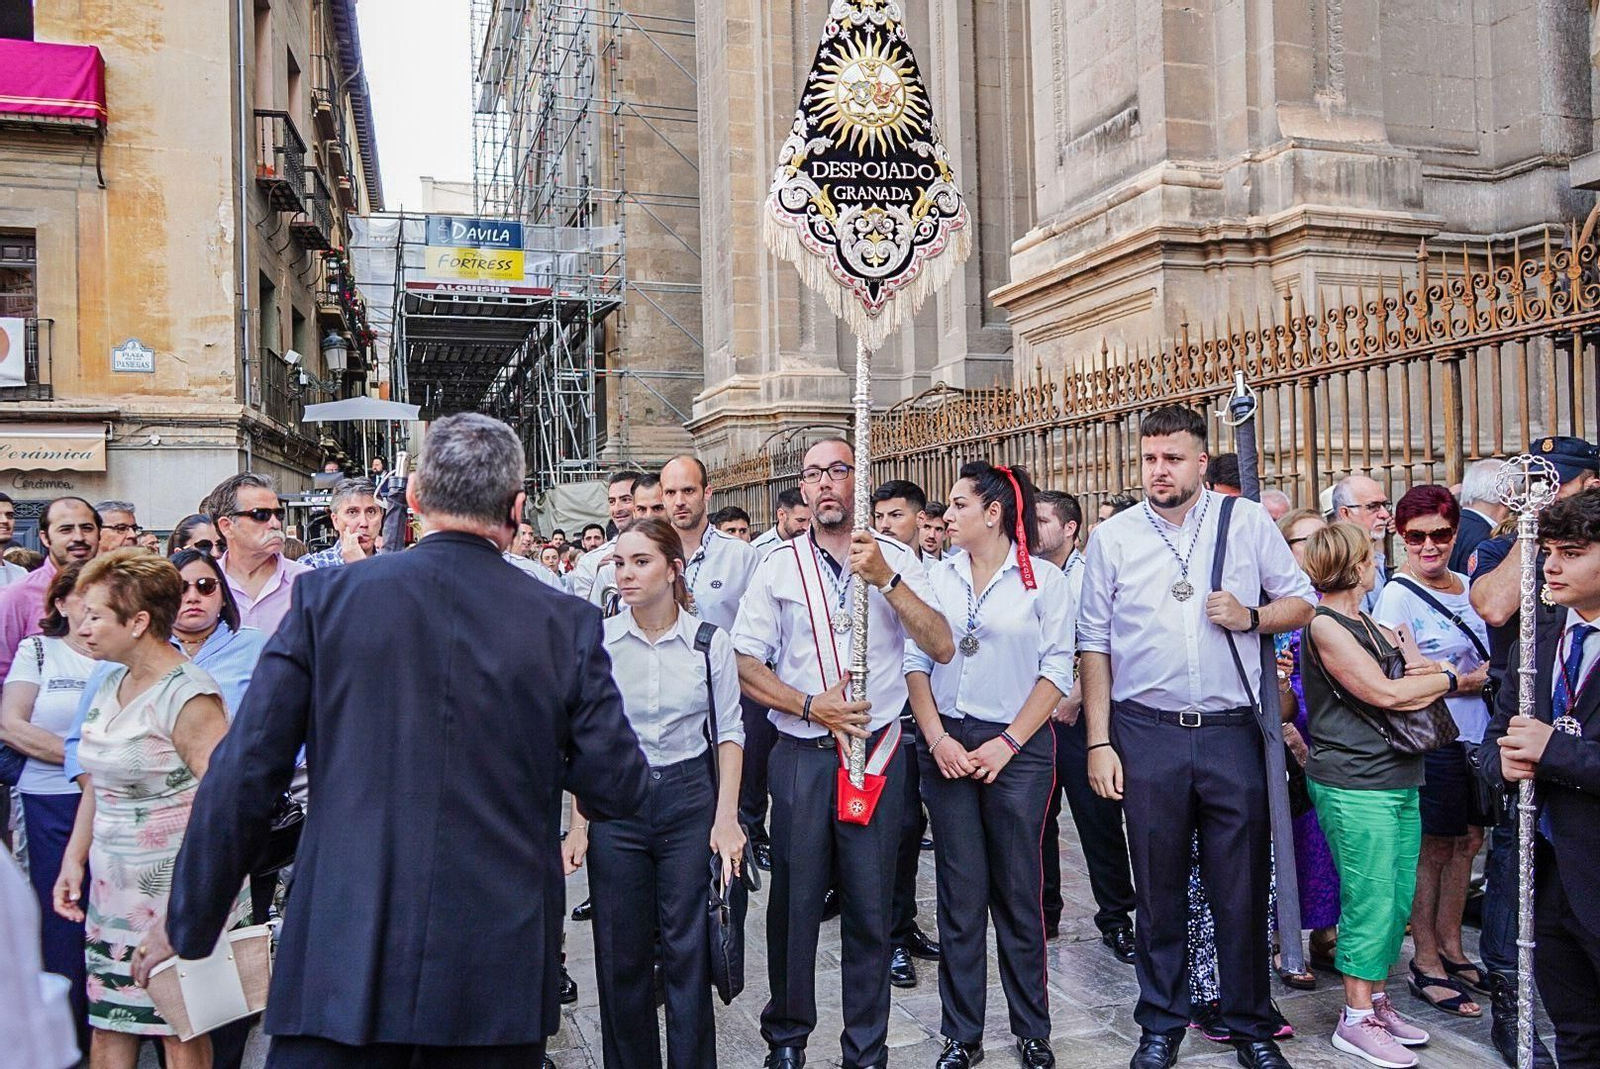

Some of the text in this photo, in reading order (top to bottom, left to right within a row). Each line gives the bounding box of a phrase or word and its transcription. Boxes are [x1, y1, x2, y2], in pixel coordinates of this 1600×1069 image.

[811, 160, 935, 181] DESPOJADO
[833, 185, 914, 201] GRANADA
[452, 221, 510, 241] DAVILA
[437, 253, 514, 271] FORTRESS
